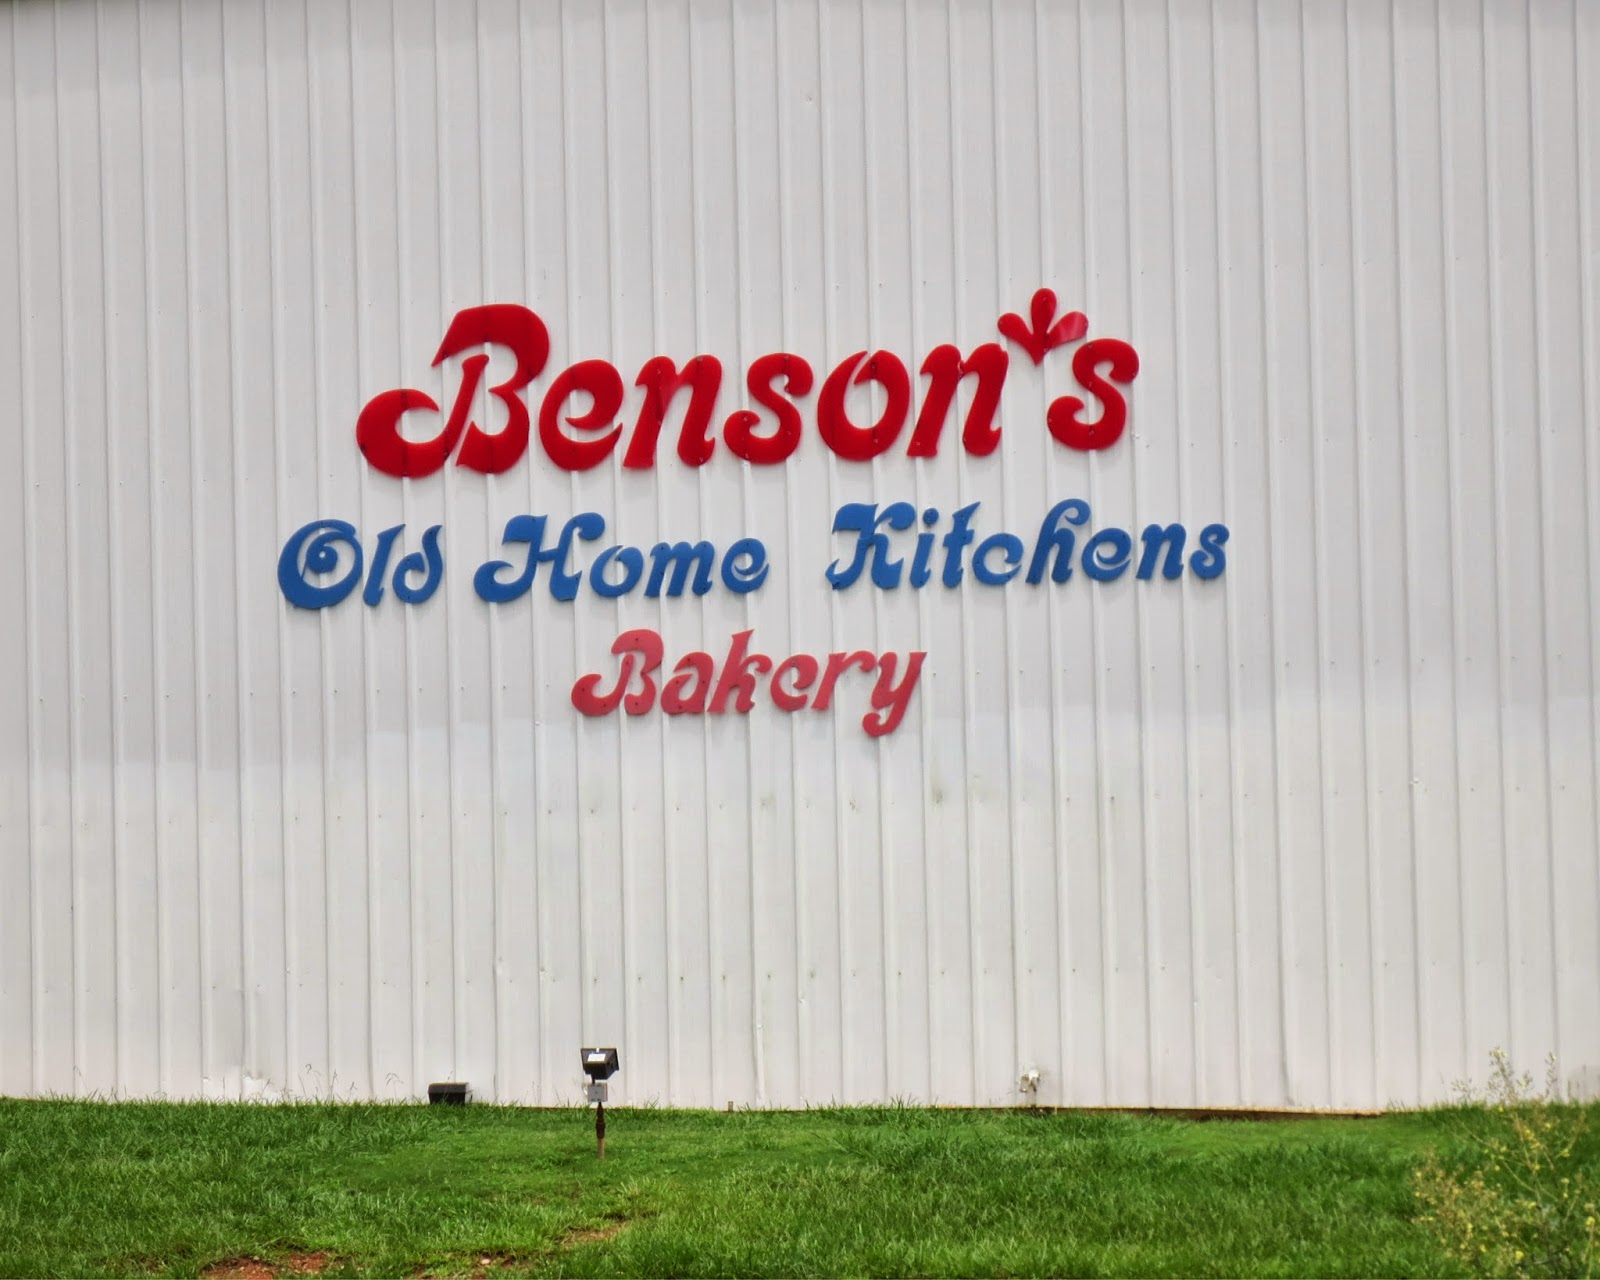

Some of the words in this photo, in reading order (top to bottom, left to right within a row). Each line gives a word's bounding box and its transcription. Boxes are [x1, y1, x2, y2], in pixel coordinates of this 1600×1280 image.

[356, 288, 1140, 479] Benson's
[278, 520, 446, 610] Old
[473, 512, 769, 603] Home
[826, 499, 1231, 590] Kitchens
[571, 629, 927, 737] Bakery
